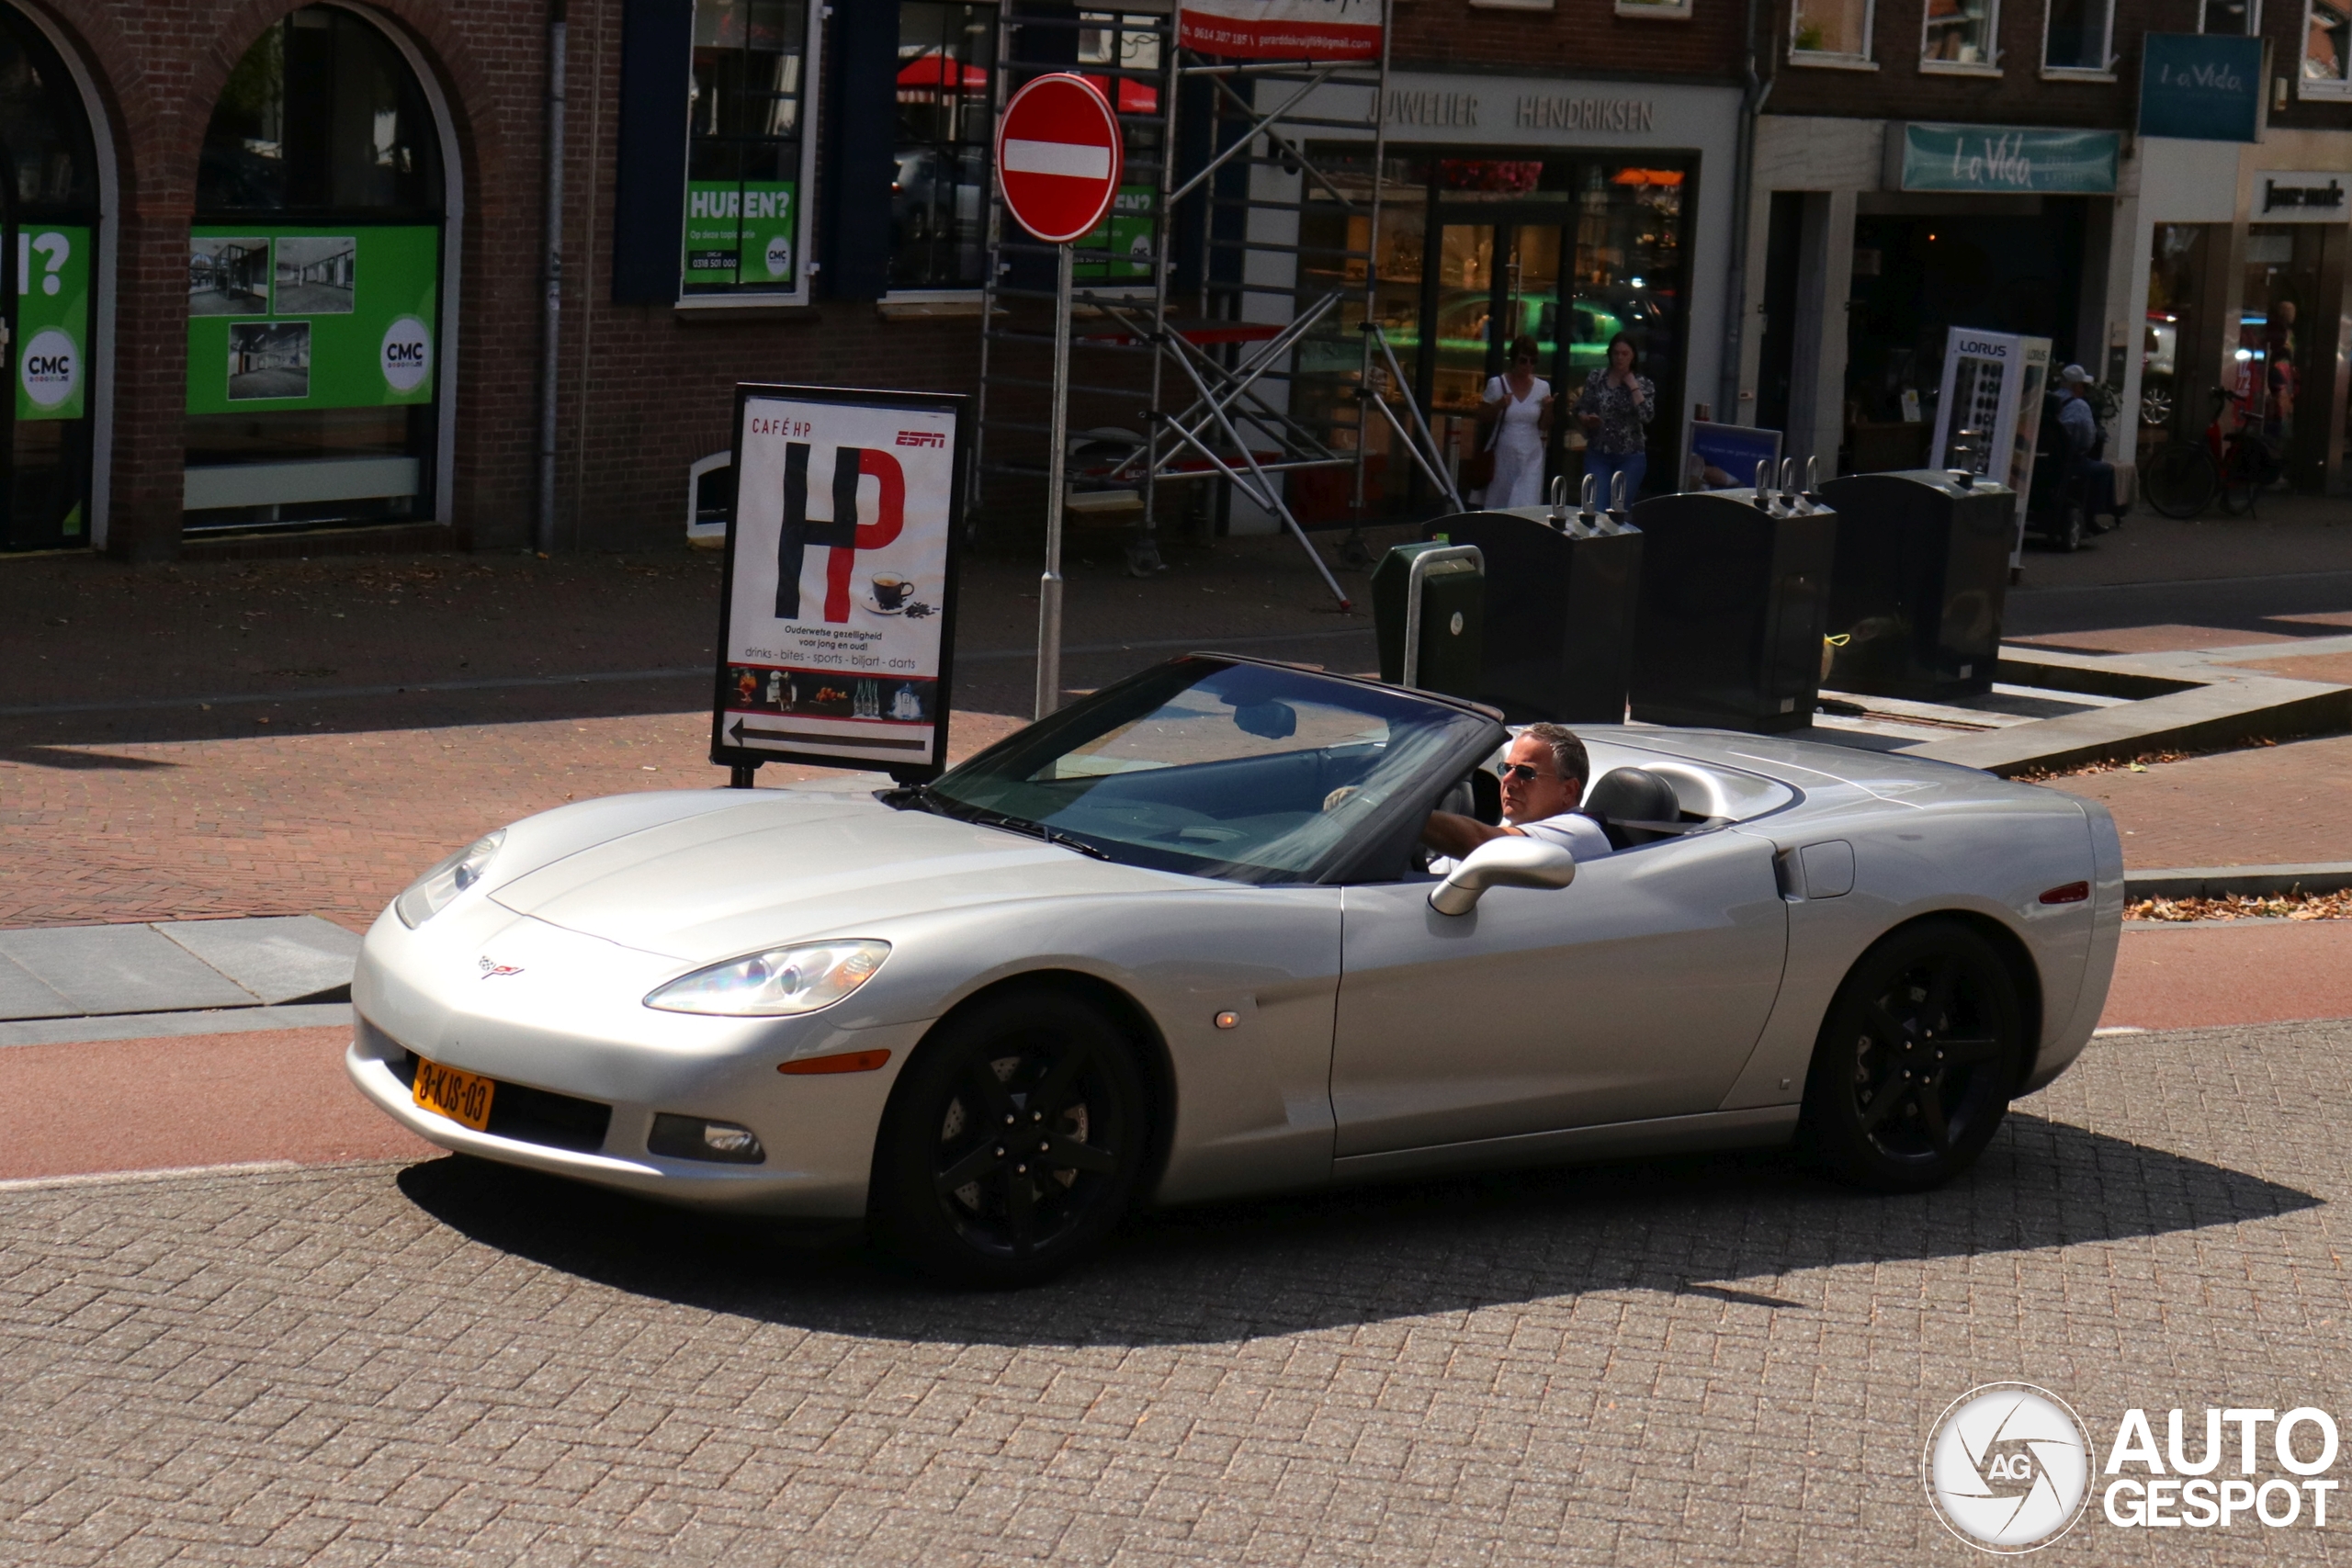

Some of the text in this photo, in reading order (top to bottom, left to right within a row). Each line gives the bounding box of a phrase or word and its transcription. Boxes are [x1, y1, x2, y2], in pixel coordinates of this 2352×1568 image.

[1194, 27, 1214, 39] 0614
[2161, 61, 2243, 92] La Vida
[1367, 90, 1653, 131] JUWELIER HENDRIKSEN
[1953, 132, 2033, 188] La Vida
[690, 191, 790, 219] HUREN?
[693, 258, 737, 268] 0318 501 000
[768, 250, 786, 260] CMC
[387, 343, 424, 361] CMC
[1960, 340, 2007, 357] LORUS
[28, 355, 69, 375] CMC
[895, 431, 945, 448] ESPN
[775, 442, 906, 624] HP
[785, 625, 882, 641] Ouderwetse gezelligheid
[798, 639, 816, 648] voor
[817, 640, 836, 651] jong
[850, 641, 868, 651] oud!
[745, 646, 772, 660] drinks
[780, 649, 804, 661] bites
[813, 652, 842, 665] sports
[852, 655, 880, 669] biljart
[888, 657, 916, 670] darts
[420, 1064, 486, 1122] 3-KJS-03
